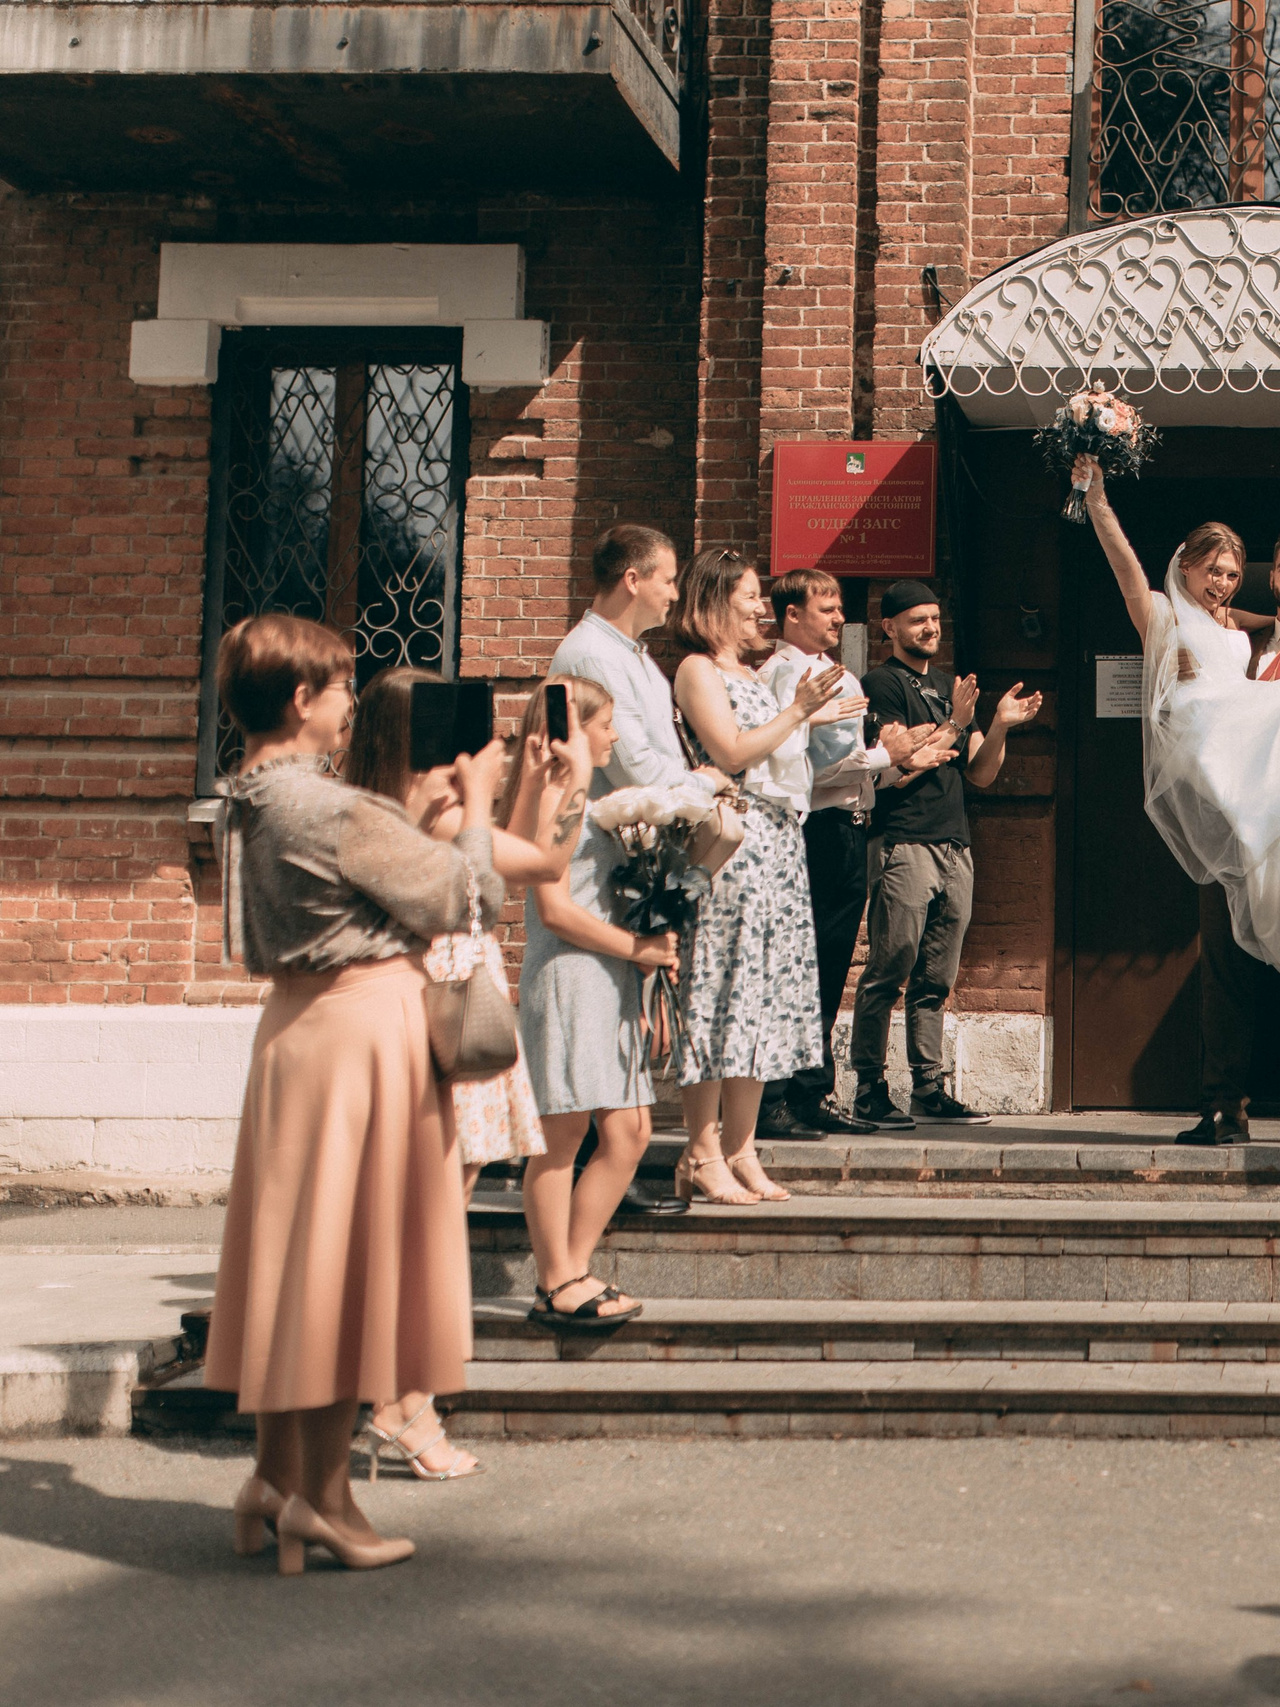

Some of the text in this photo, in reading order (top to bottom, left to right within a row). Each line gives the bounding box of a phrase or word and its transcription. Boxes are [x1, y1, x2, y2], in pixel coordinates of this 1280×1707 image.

[807, 518, 902, 531] ОТДЕЛ ЗАГС
[858, 532, 867, 544] 1
